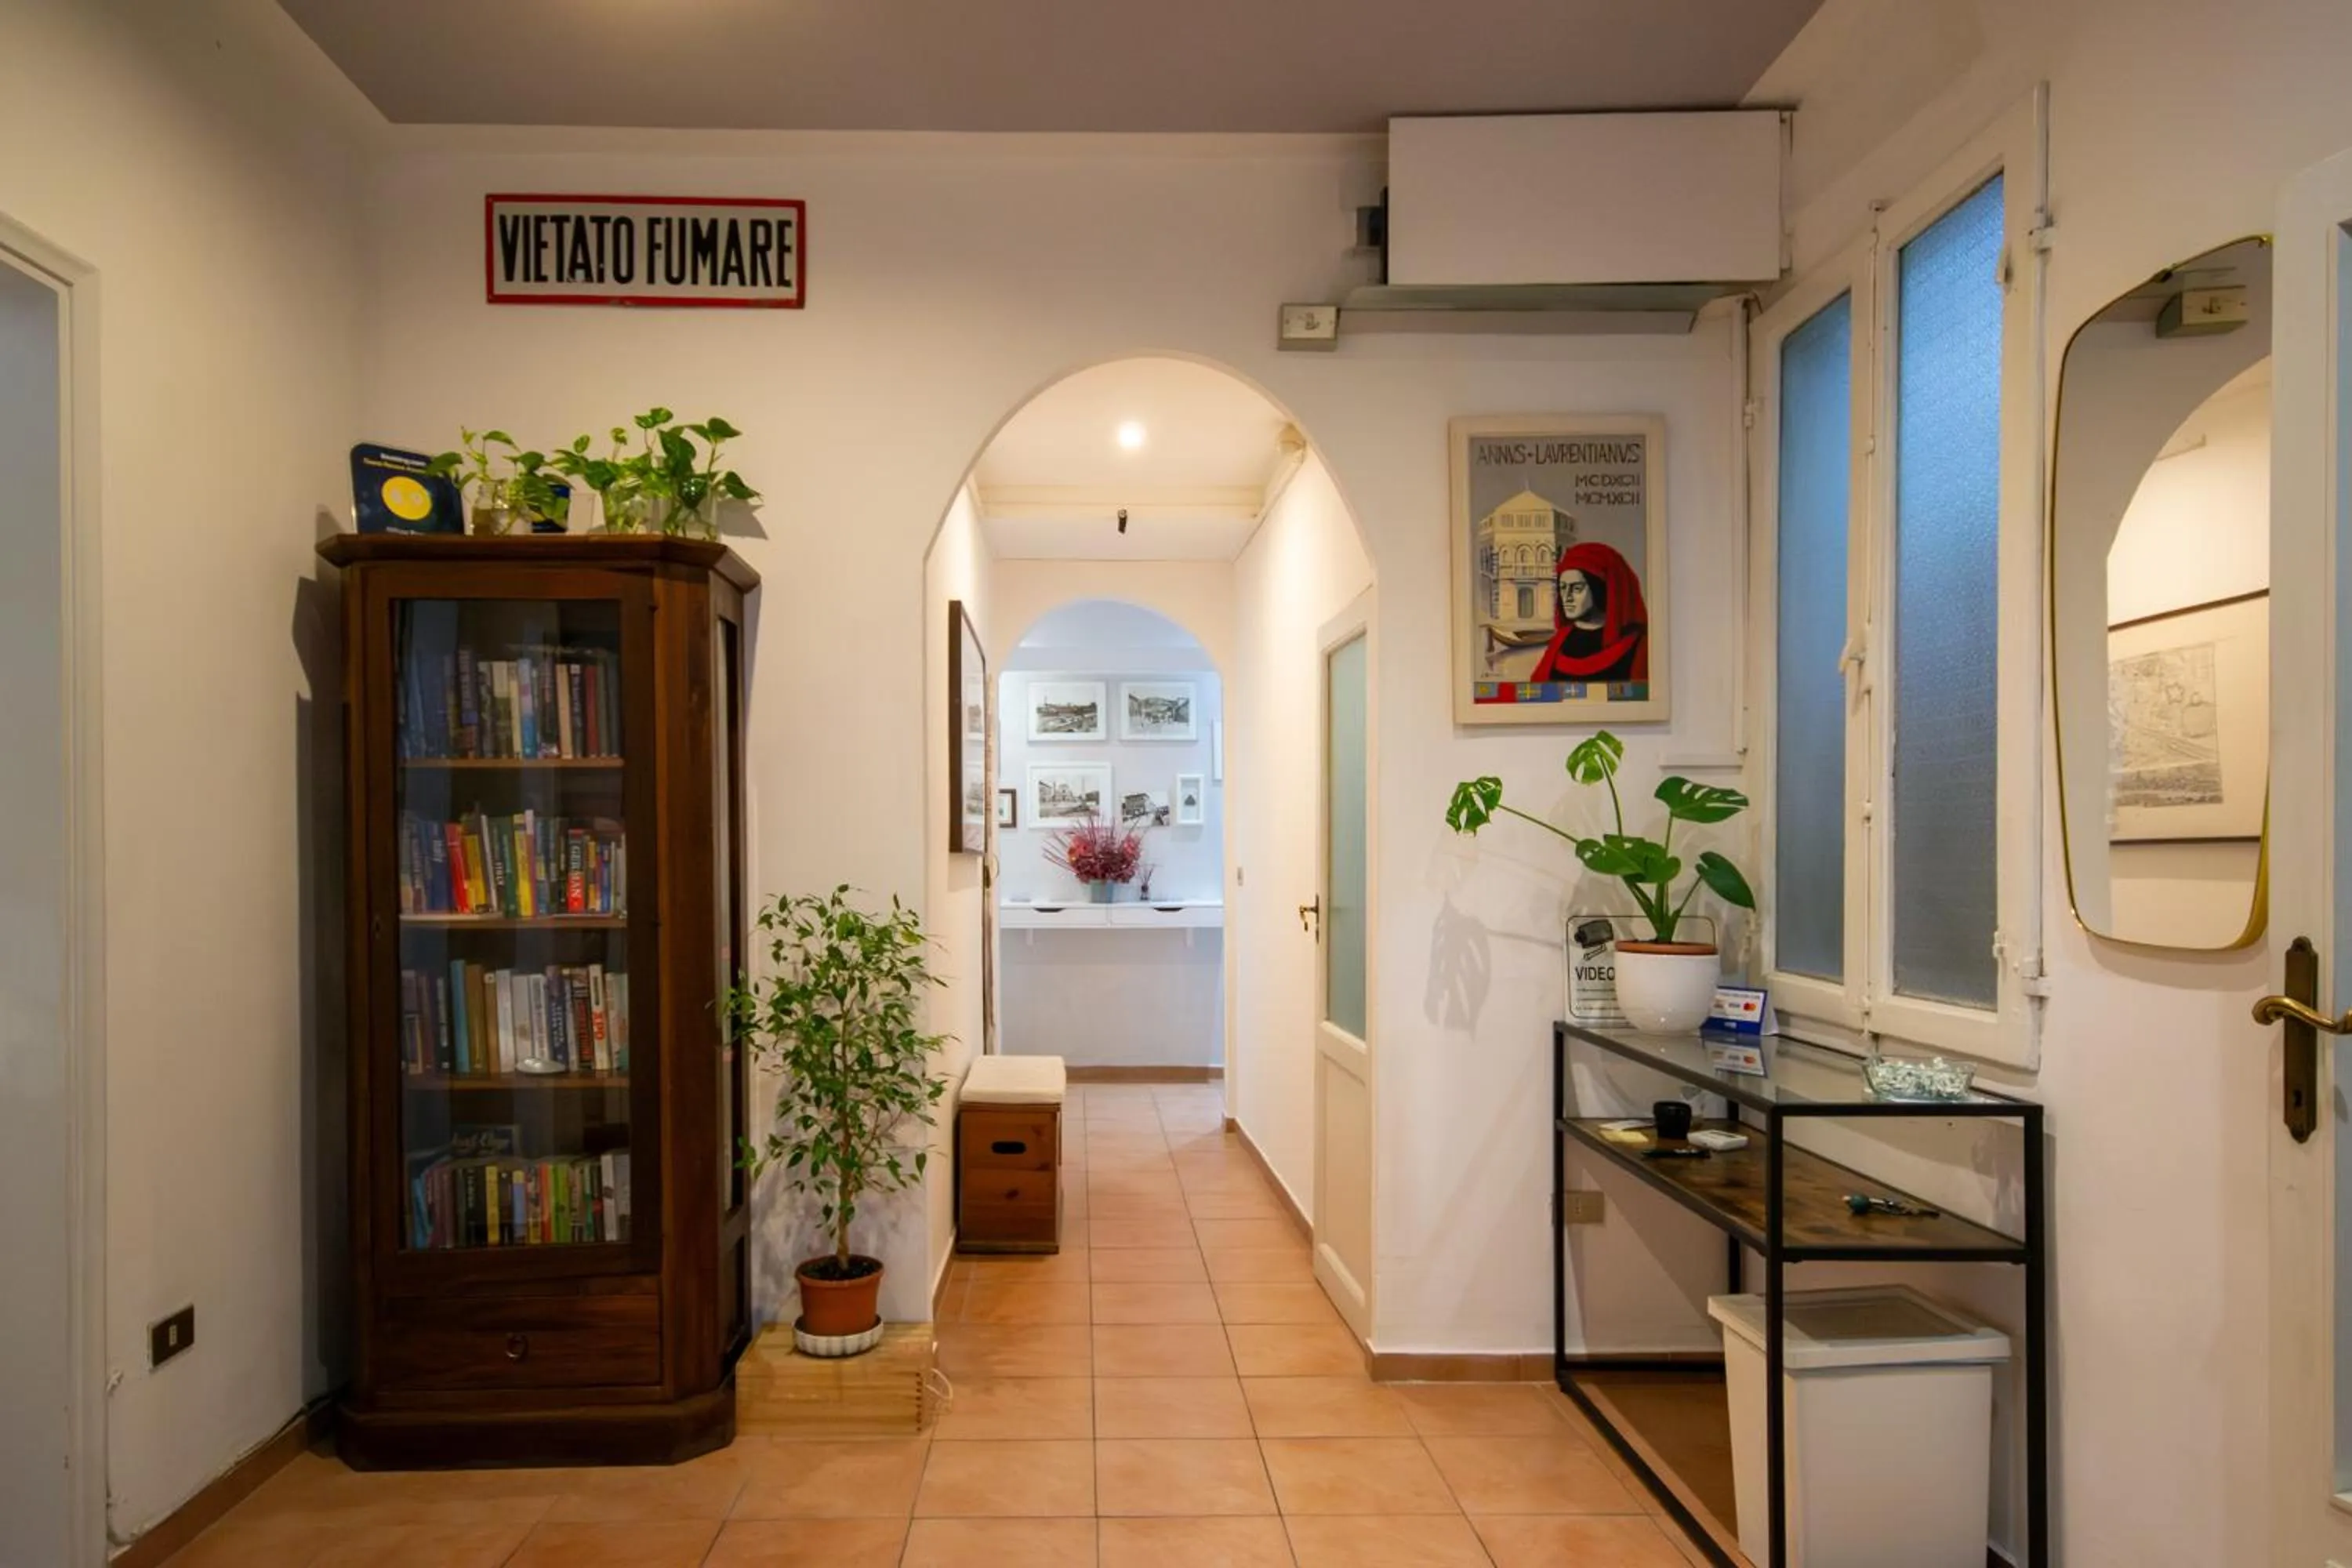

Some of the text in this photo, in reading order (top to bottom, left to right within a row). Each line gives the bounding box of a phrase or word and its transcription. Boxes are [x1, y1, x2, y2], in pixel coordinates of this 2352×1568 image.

[499, 213, 793, 289] VIETATO FUMARE
[1574, 473, 1641, 488] MCDXCII
